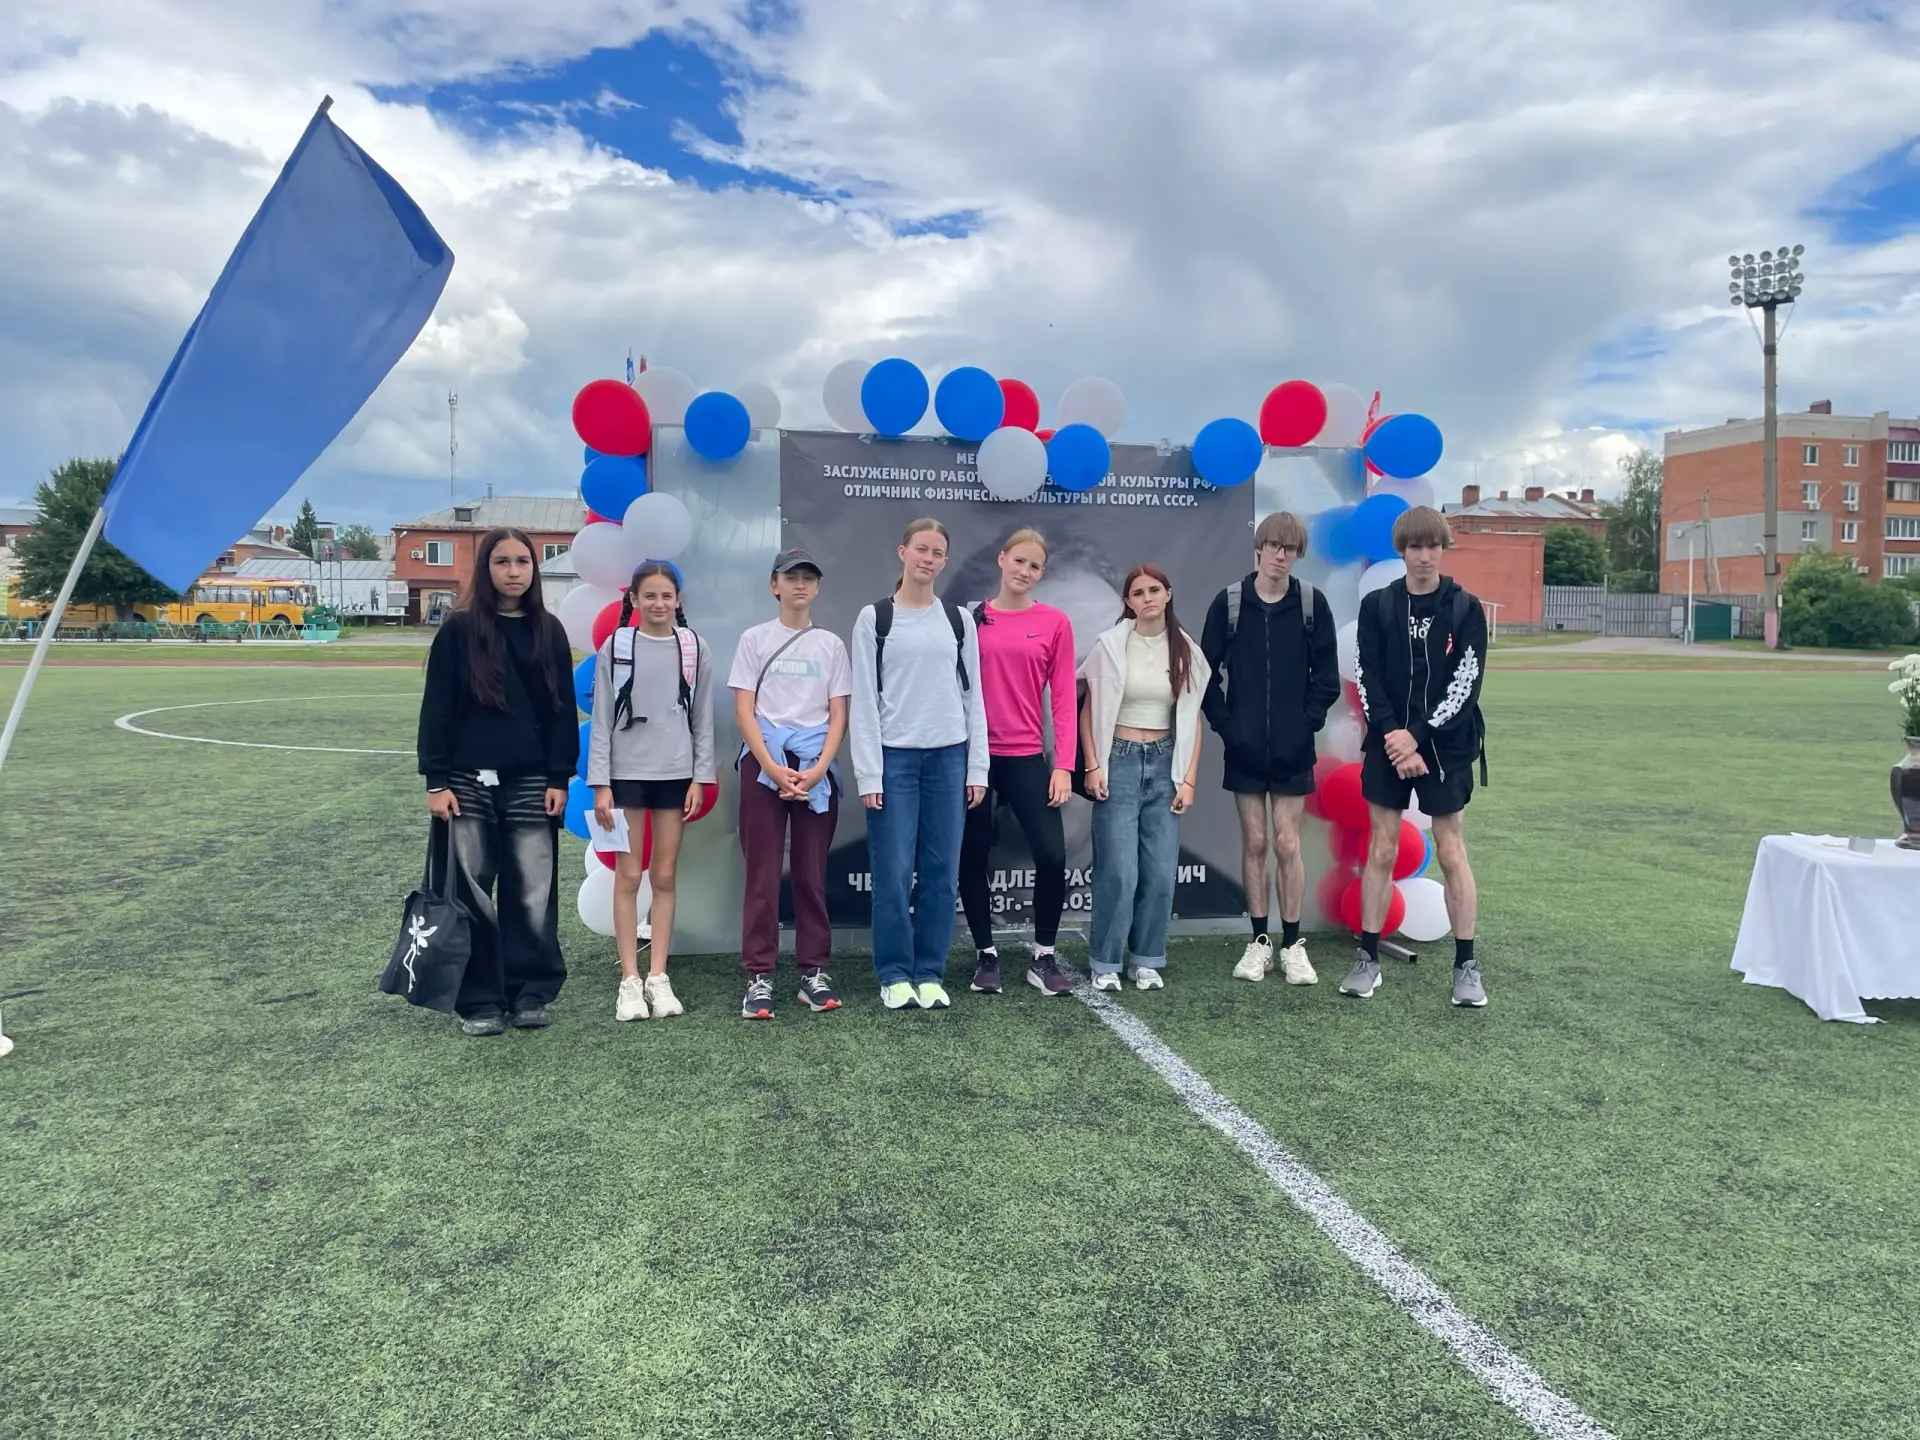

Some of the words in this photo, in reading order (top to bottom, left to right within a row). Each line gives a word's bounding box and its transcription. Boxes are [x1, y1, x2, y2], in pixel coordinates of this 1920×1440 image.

[823, 465, 936, 481] ЗАСЛУЖЕННОГО
[1120, 475, 1189, 489] КУЛЬТУРЫ
[843, 484, 921, 499] ОТЛИЧНИК
[1097, 492, 1106, 504] И
[1110, 493, 1160, 506] СПОРТА
[1163, 494, 1198, 507] СССР.
